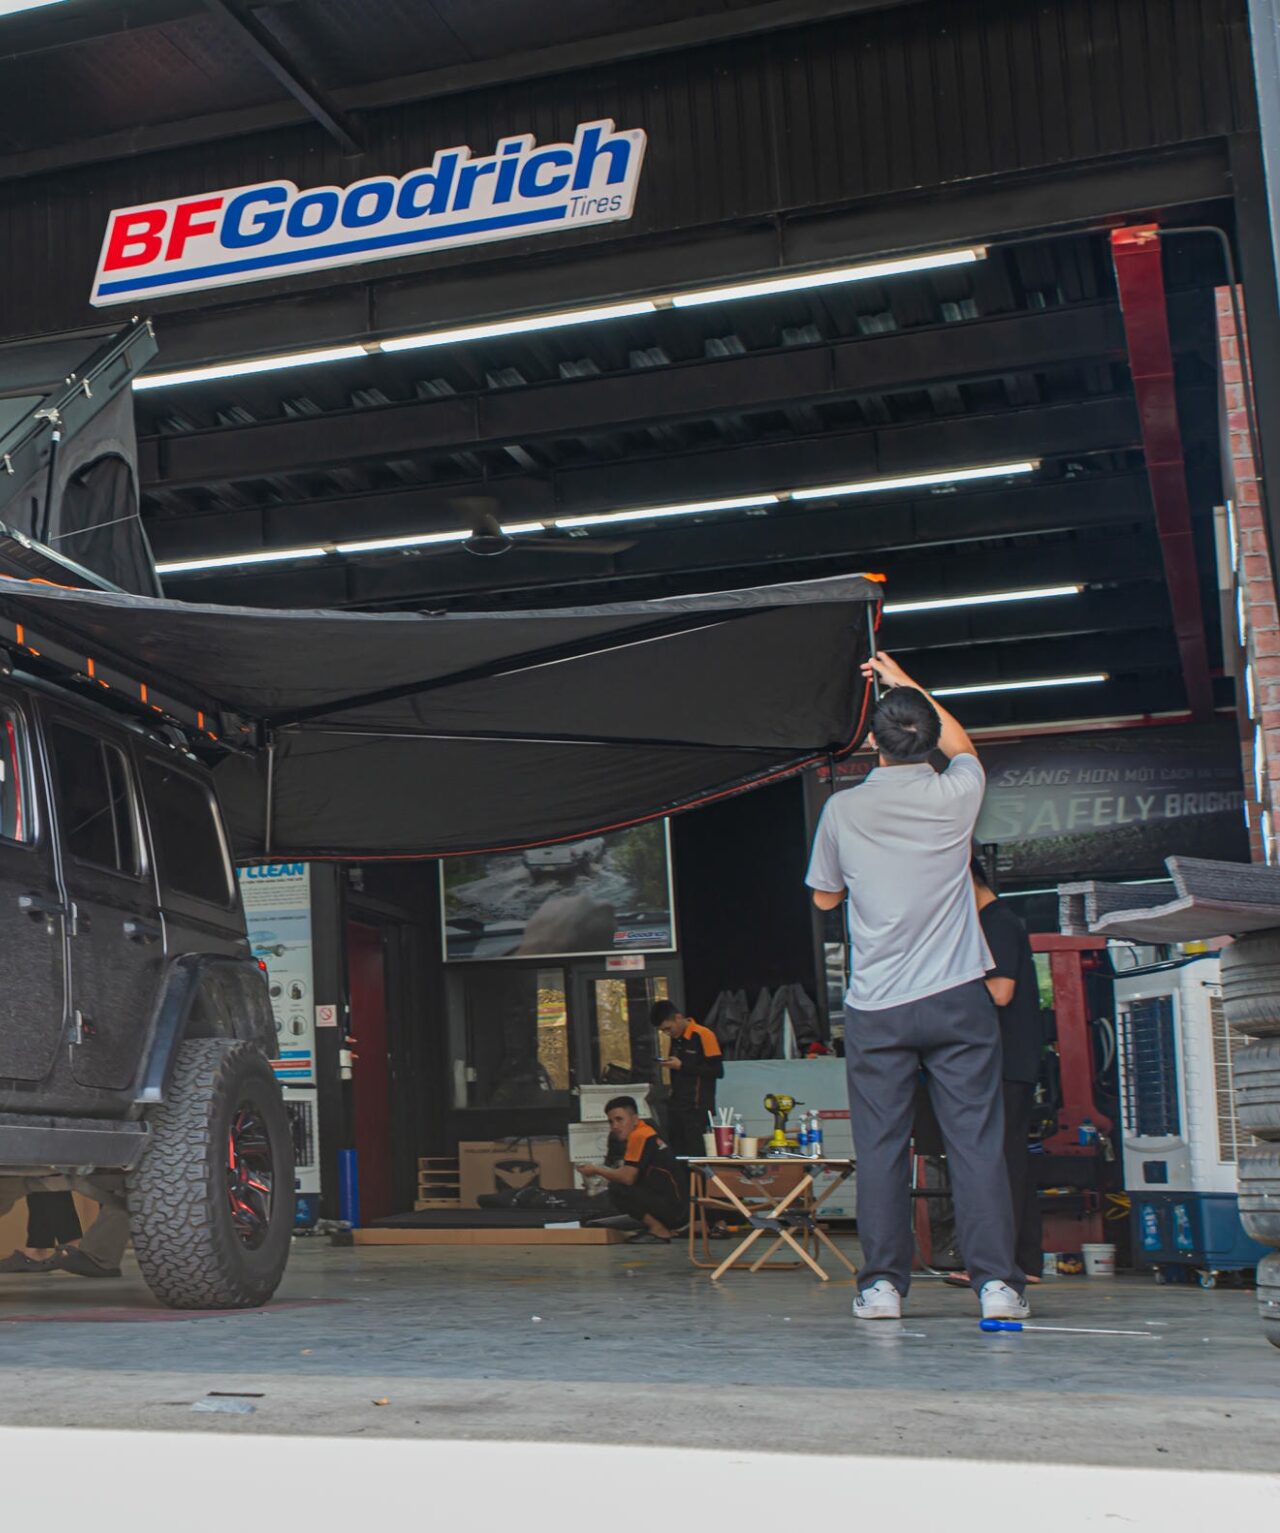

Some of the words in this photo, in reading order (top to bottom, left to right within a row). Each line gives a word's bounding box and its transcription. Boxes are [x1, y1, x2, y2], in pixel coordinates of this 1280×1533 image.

[103, 127, 631, 272] BFGoodrich
[569, 193, 623, 218] Tires
[998, 766, 1071, 788] SÁNG
[984, 795, 1155, 840] SAFELY
